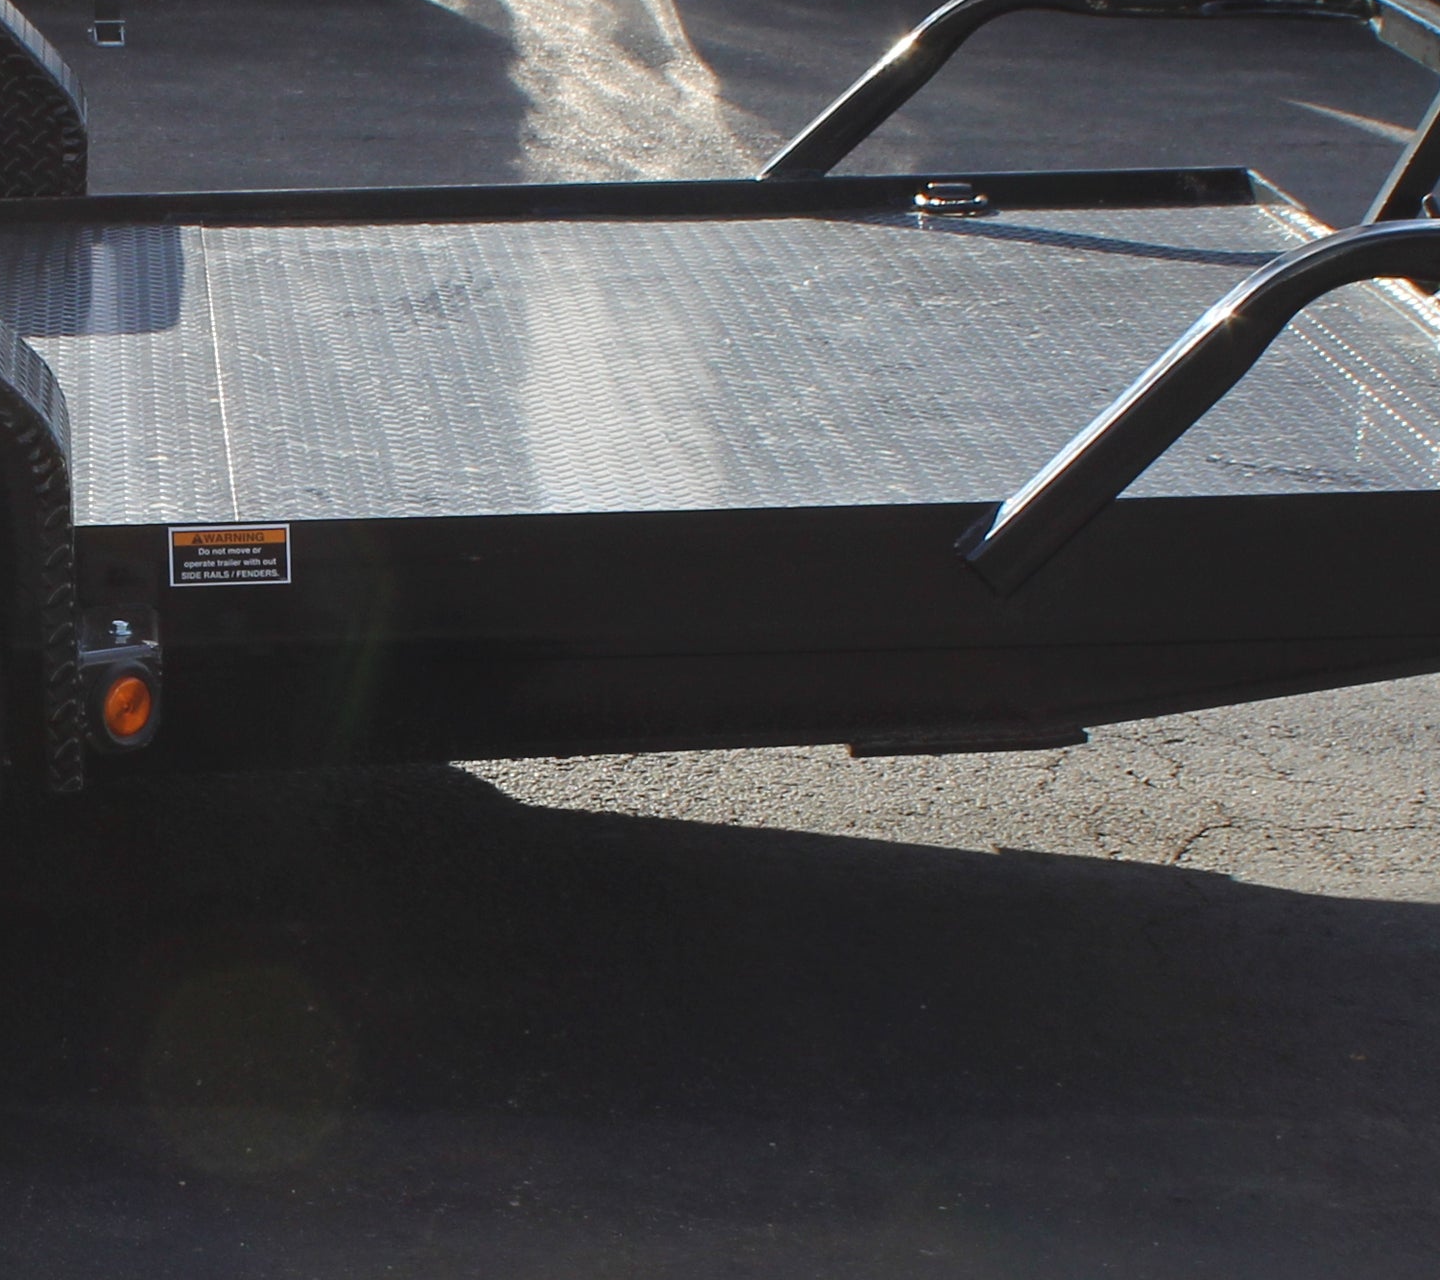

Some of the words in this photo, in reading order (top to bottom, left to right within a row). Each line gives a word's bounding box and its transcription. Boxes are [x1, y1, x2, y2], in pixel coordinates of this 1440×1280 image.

[203, 531, 265, 543] WARNING
[198, 548, 210, 556] Do
[212, 547, 226, 555] not
[183, 560, 215, 569] operate
[217, 559, 242, 567] trailer
[262, 558, 277, 566] out
[181, 571, 202, 580] SIDE
[203, 570, 230, 579] RAILS
[236, 569, 280, 578] FENDERS.
